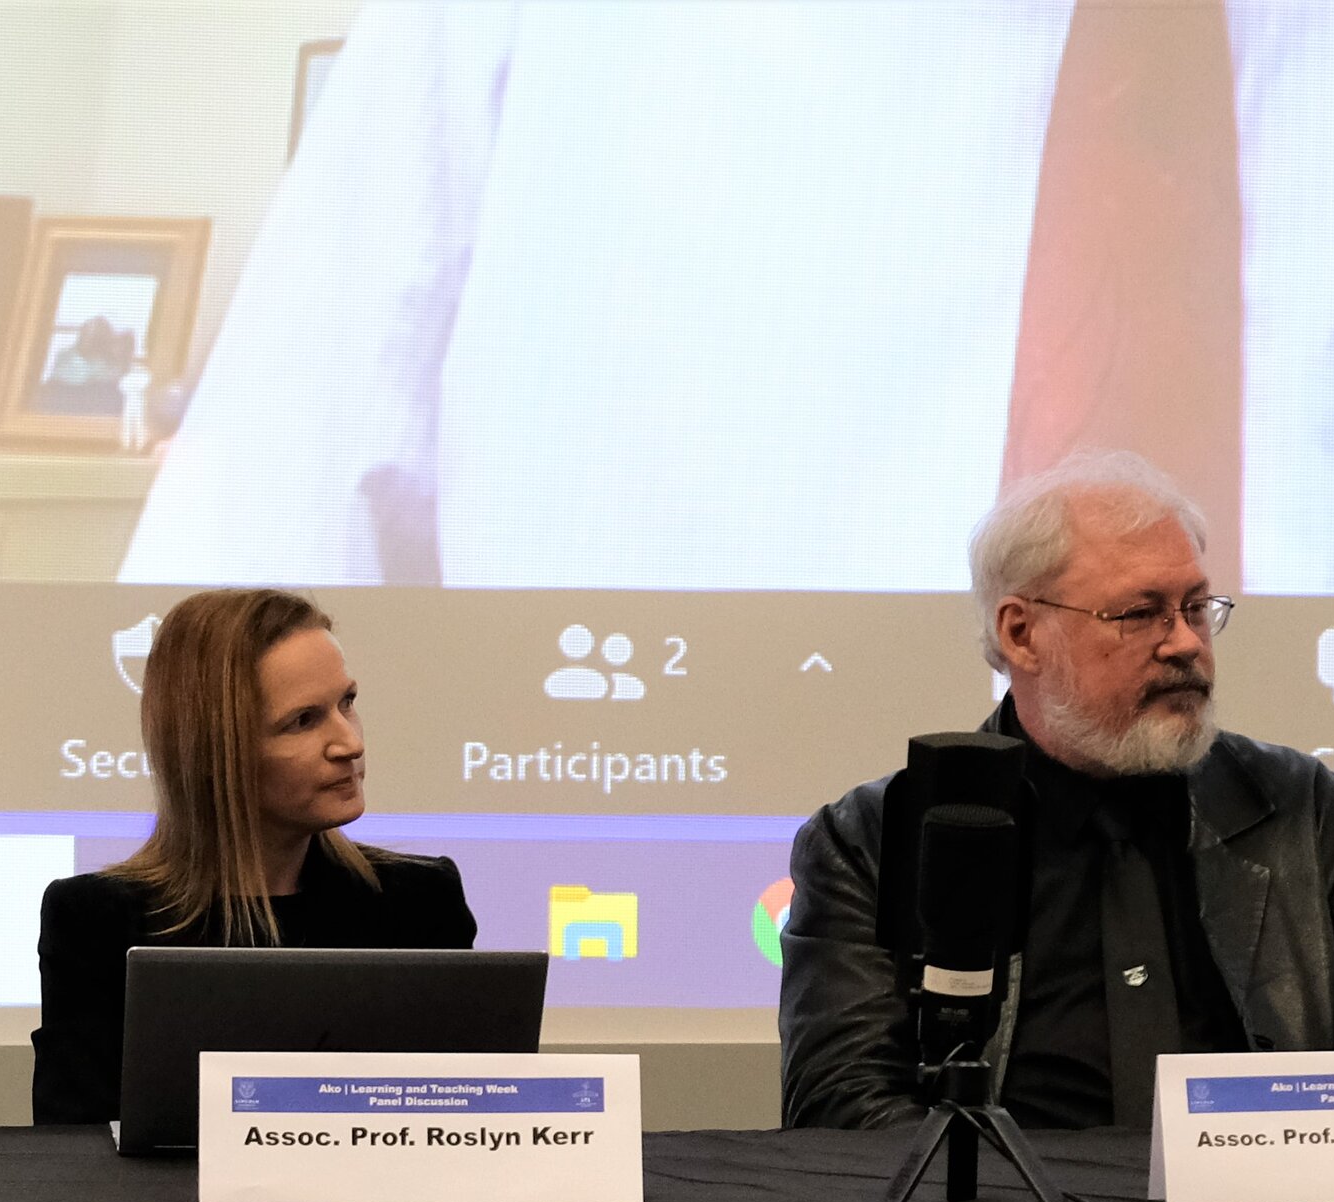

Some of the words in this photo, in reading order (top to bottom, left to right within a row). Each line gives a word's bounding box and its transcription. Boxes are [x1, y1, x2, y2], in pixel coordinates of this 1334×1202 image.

[663, 634, 688, 676] 2
[462, 741, 729, 794] Participants
[319, 1084, 342, 1094] Ako
[351, 1084, 403, 1096] Learning
[405, 1085, 428, 1094] and
[430, 1084, 483, 1096] Teaching
[485, 1084, 518, 1094] Week
[369, 1097, 402, 1107] Panel
[405, 1097, 468, 1107] Discussion
[244, 1127, 340, 1146] Assoc.
[351, 1127, 415, 1146] Prof.
[427, 1127, 521, 1151] Roslyn
[532, 1127, 594, 1145] Kerr
[1197, 1130, 1275, 1147] Assoc.
